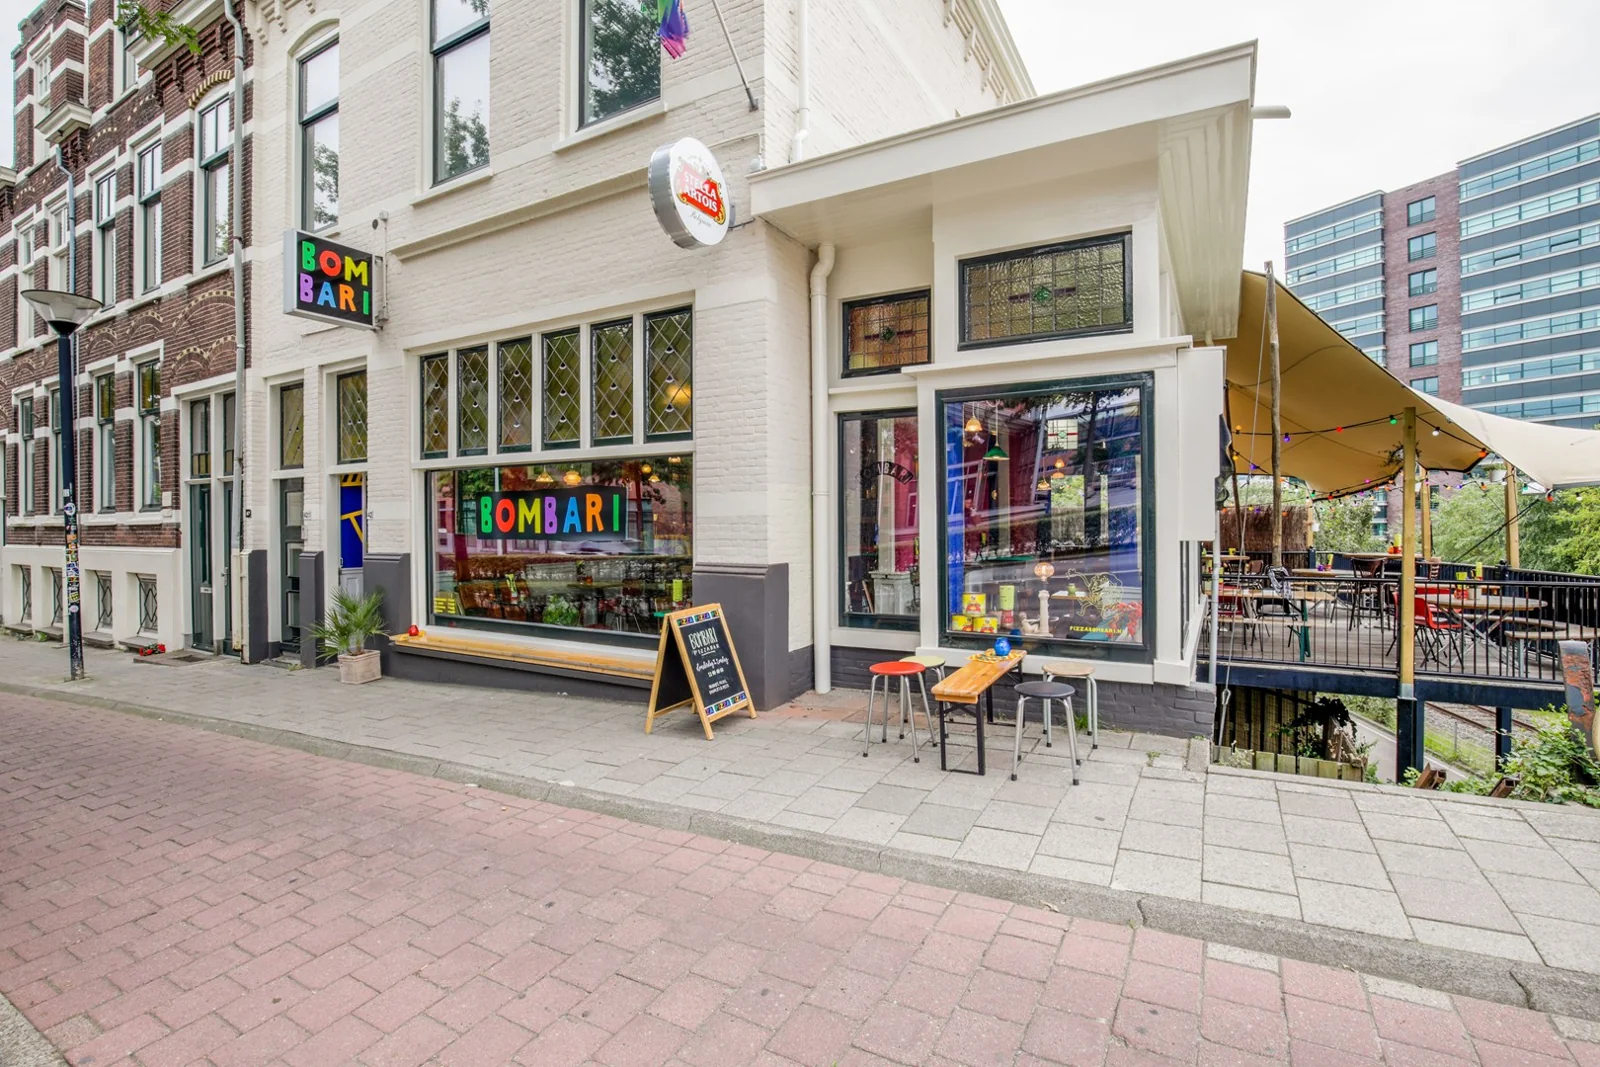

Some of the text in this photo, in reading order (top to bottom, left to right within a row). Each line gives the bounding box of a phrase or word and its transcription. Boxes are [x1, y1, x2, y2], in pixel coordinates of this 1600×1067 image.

[683, 171, 717, 200] STELLA
[684, 185, 718, 213] ARTOIS
[302, 240, 368, 287] BOM
[299, 272, 370, 315] BARI
[856, 461, 914, 485] OMBARI
[480, 493, 620, 534] BOMBARI
[688, 627, 718, 649] BOMBARI
